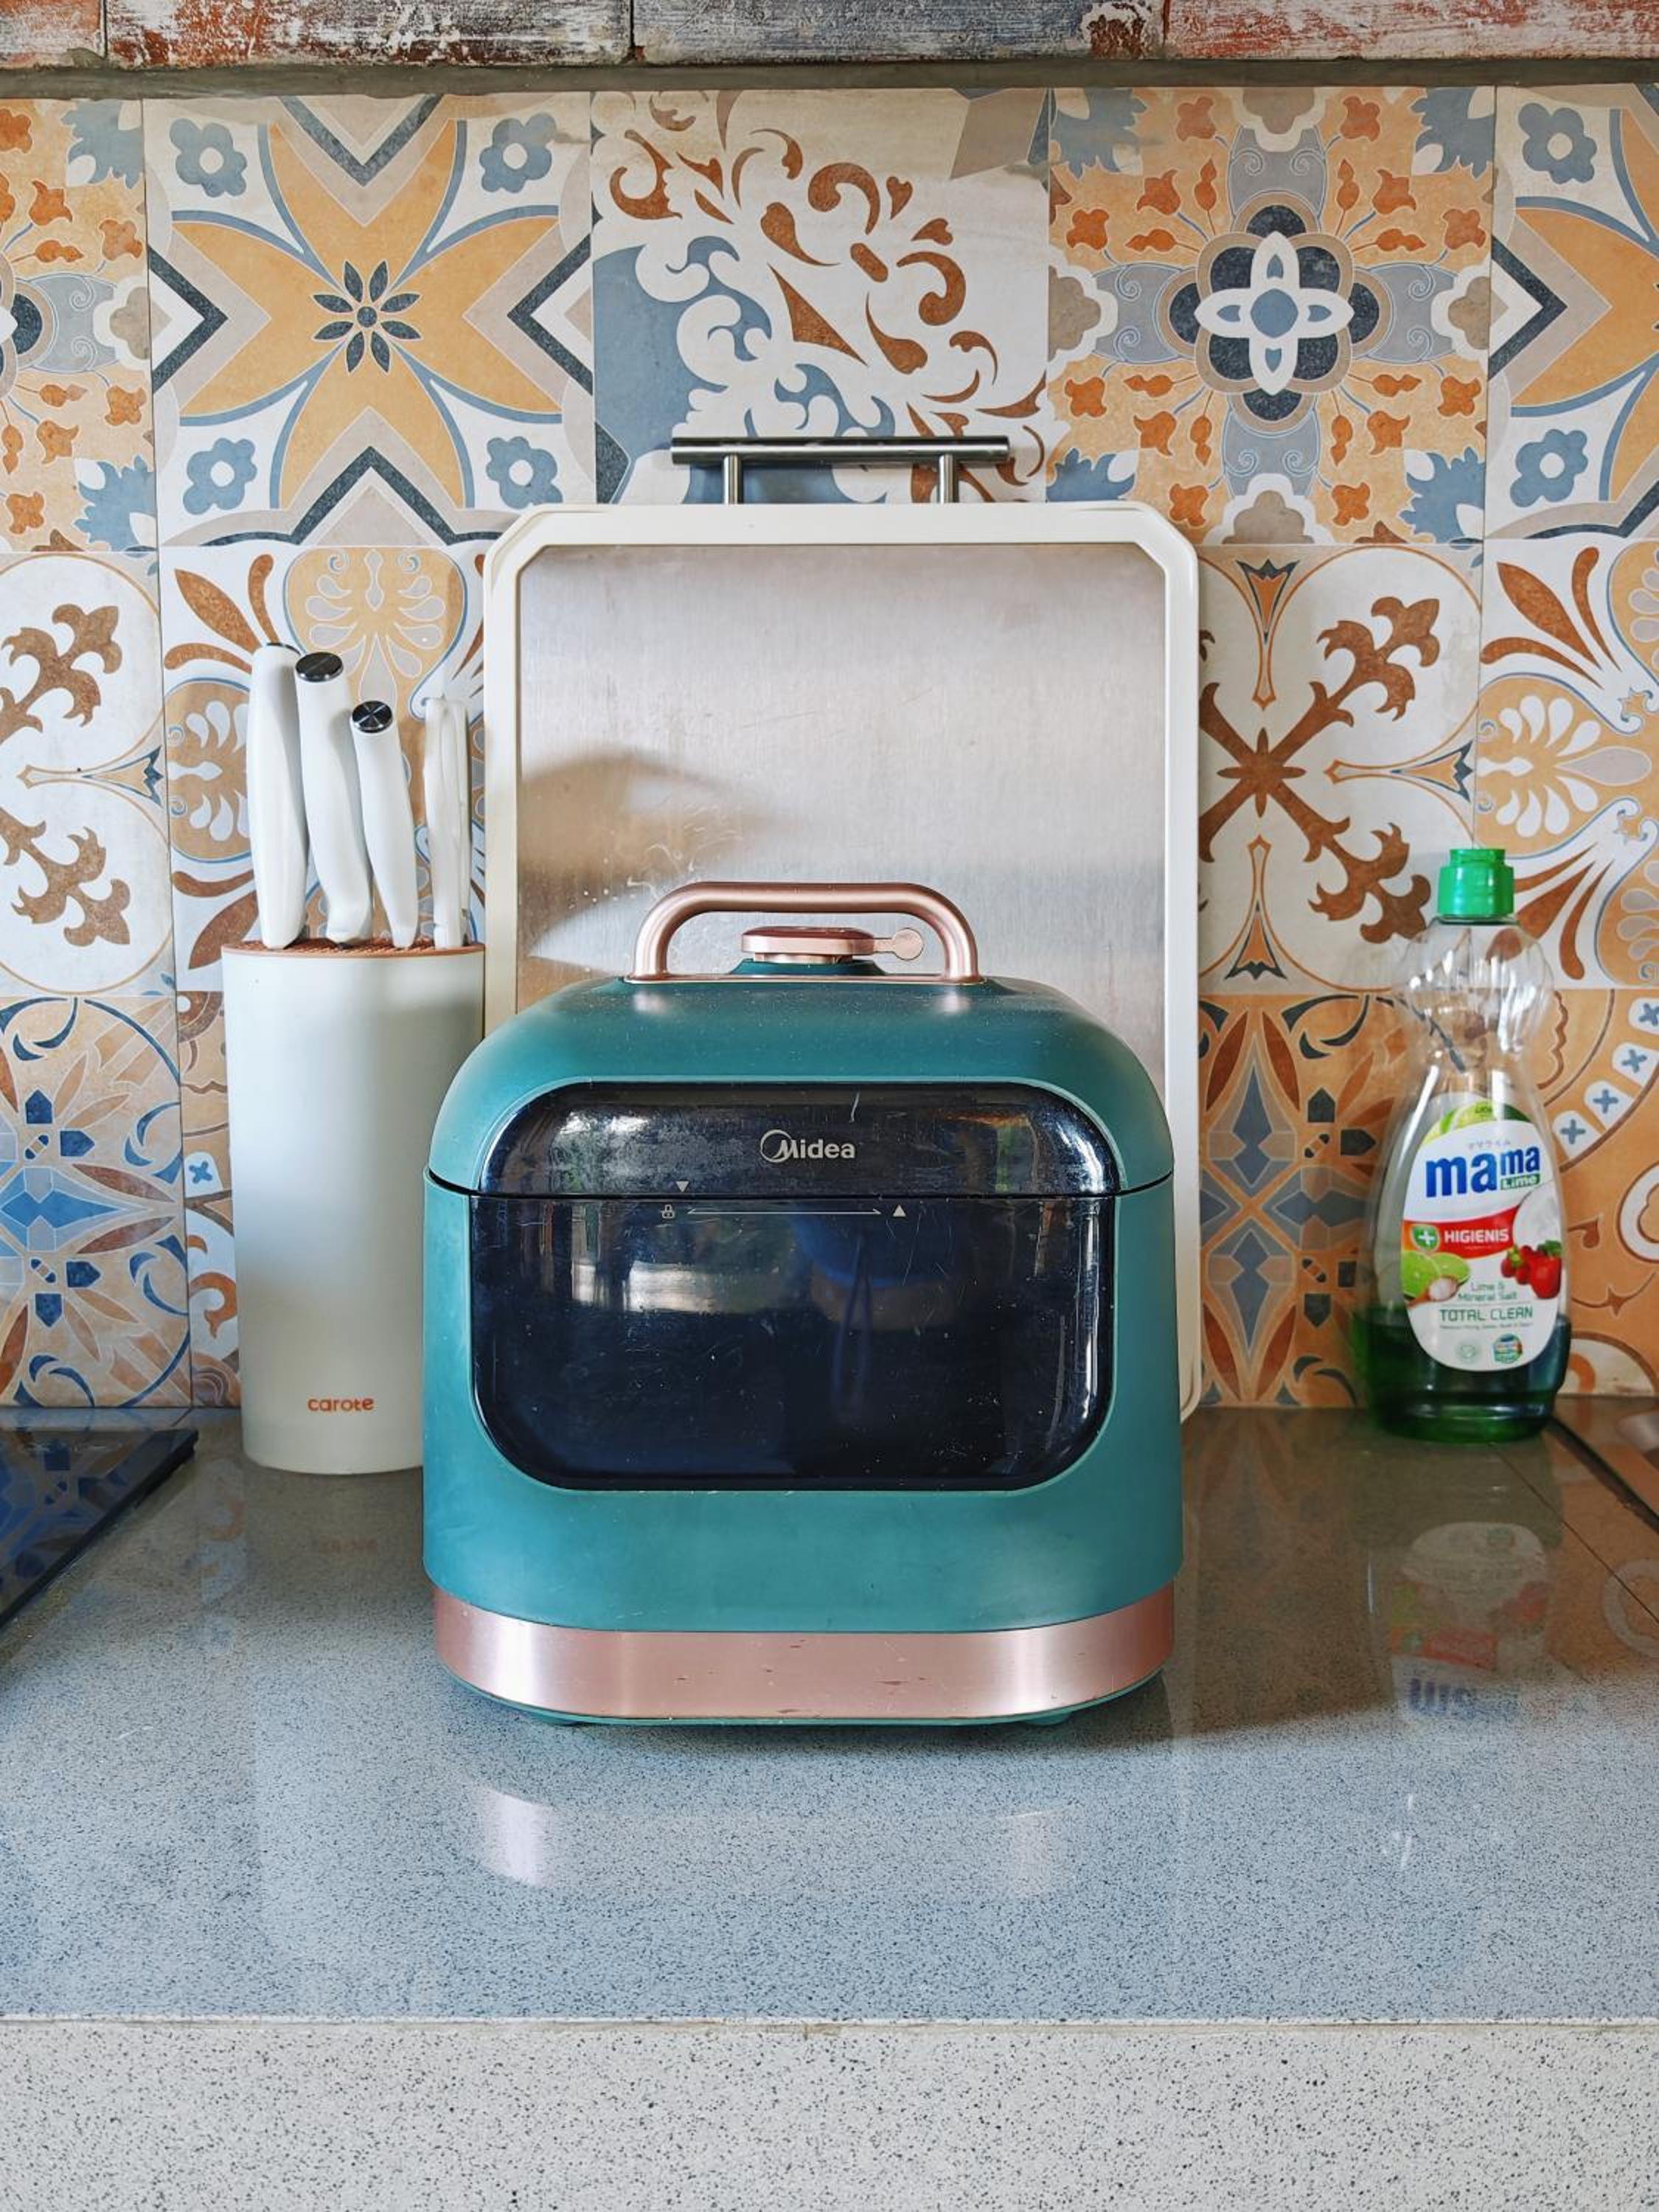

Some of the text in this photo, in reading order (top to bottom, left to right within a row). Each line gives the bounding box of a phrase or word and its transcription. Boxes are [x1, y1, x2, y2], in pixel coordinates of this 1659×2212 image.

[760, 1130, 856, 1162] Midea
[1425, 1146, 1540, 1198] mama
[1503, 1175, 1539, 1189] Lime
[1444, 1228, 1509, 1244] HIGIENIS
[1470, 1281, 1495, 1292] Lime
[1439, 1306, 1533, 1322] TOTAL CLEAN
[307, 1397, 375, 1413] carote
